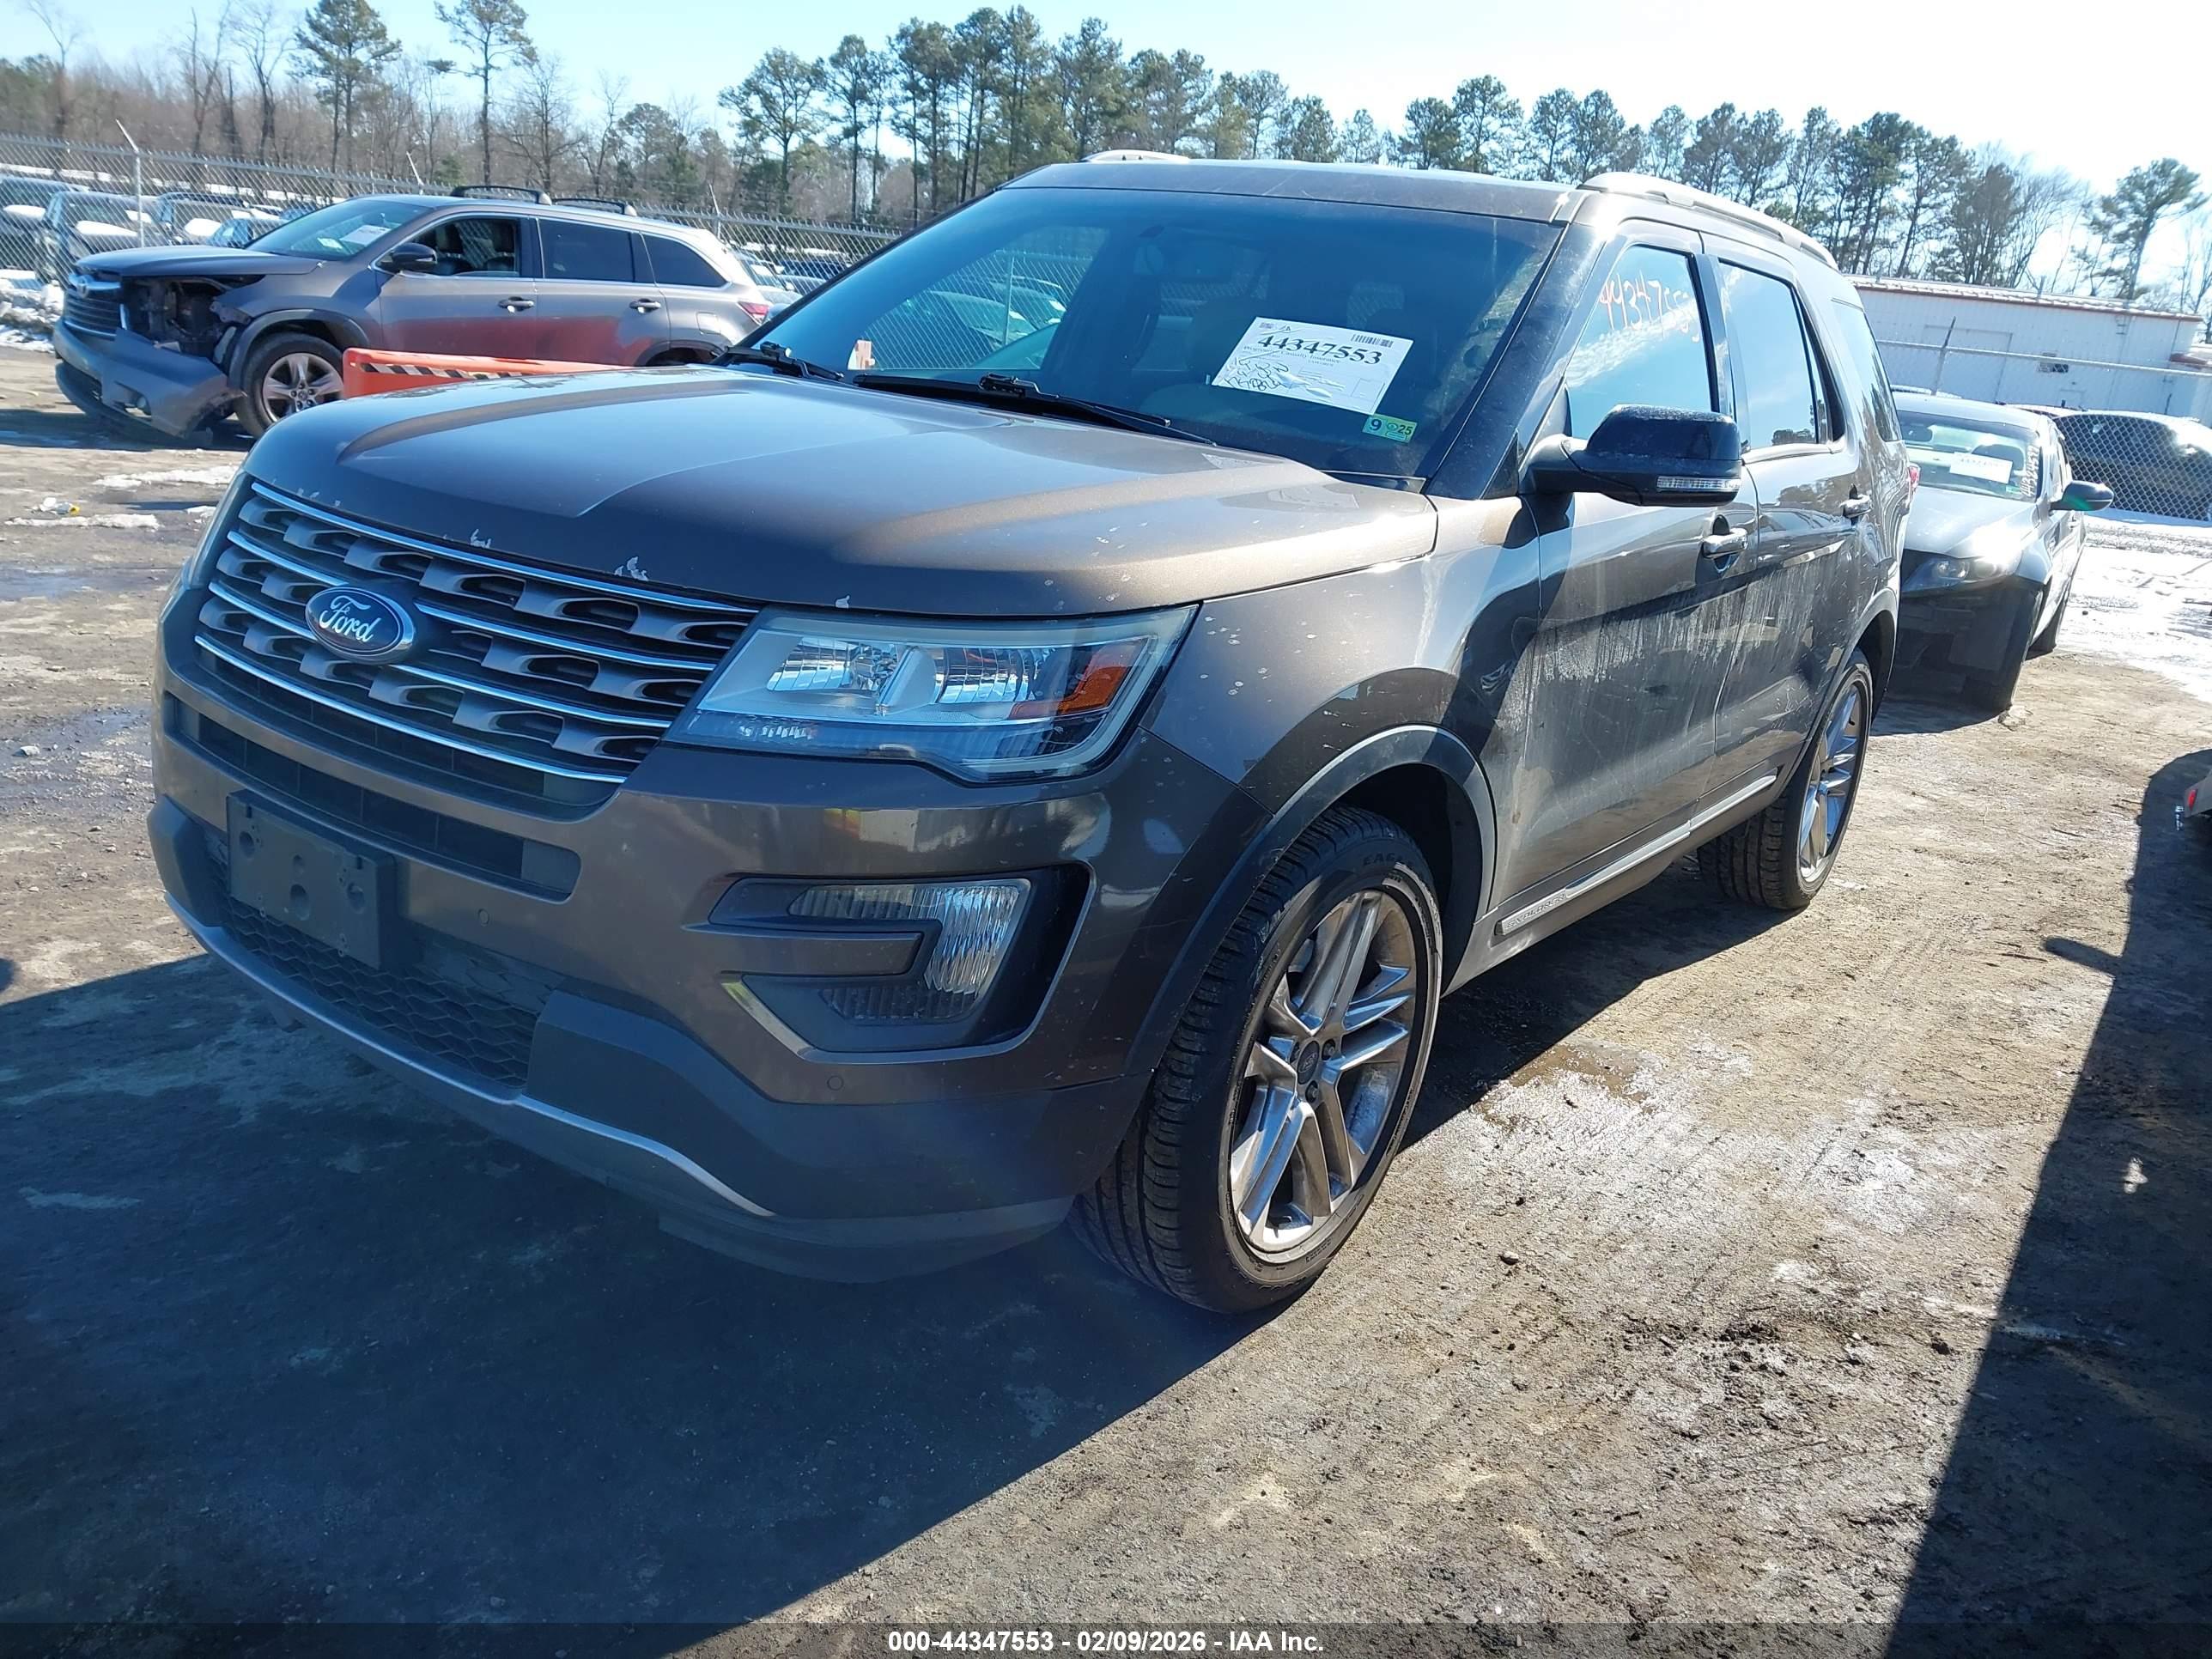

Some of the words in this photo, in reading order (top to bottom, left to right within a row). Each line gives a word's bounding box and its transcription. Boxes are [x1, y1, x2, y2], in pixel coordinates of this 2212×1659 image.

[1258, 334, 1382, 365] 44347553
[1370, 418, 1382, 431] 9
[1397, 424, 1413, 435] 25
[319, 595, 382, 642] Ford
